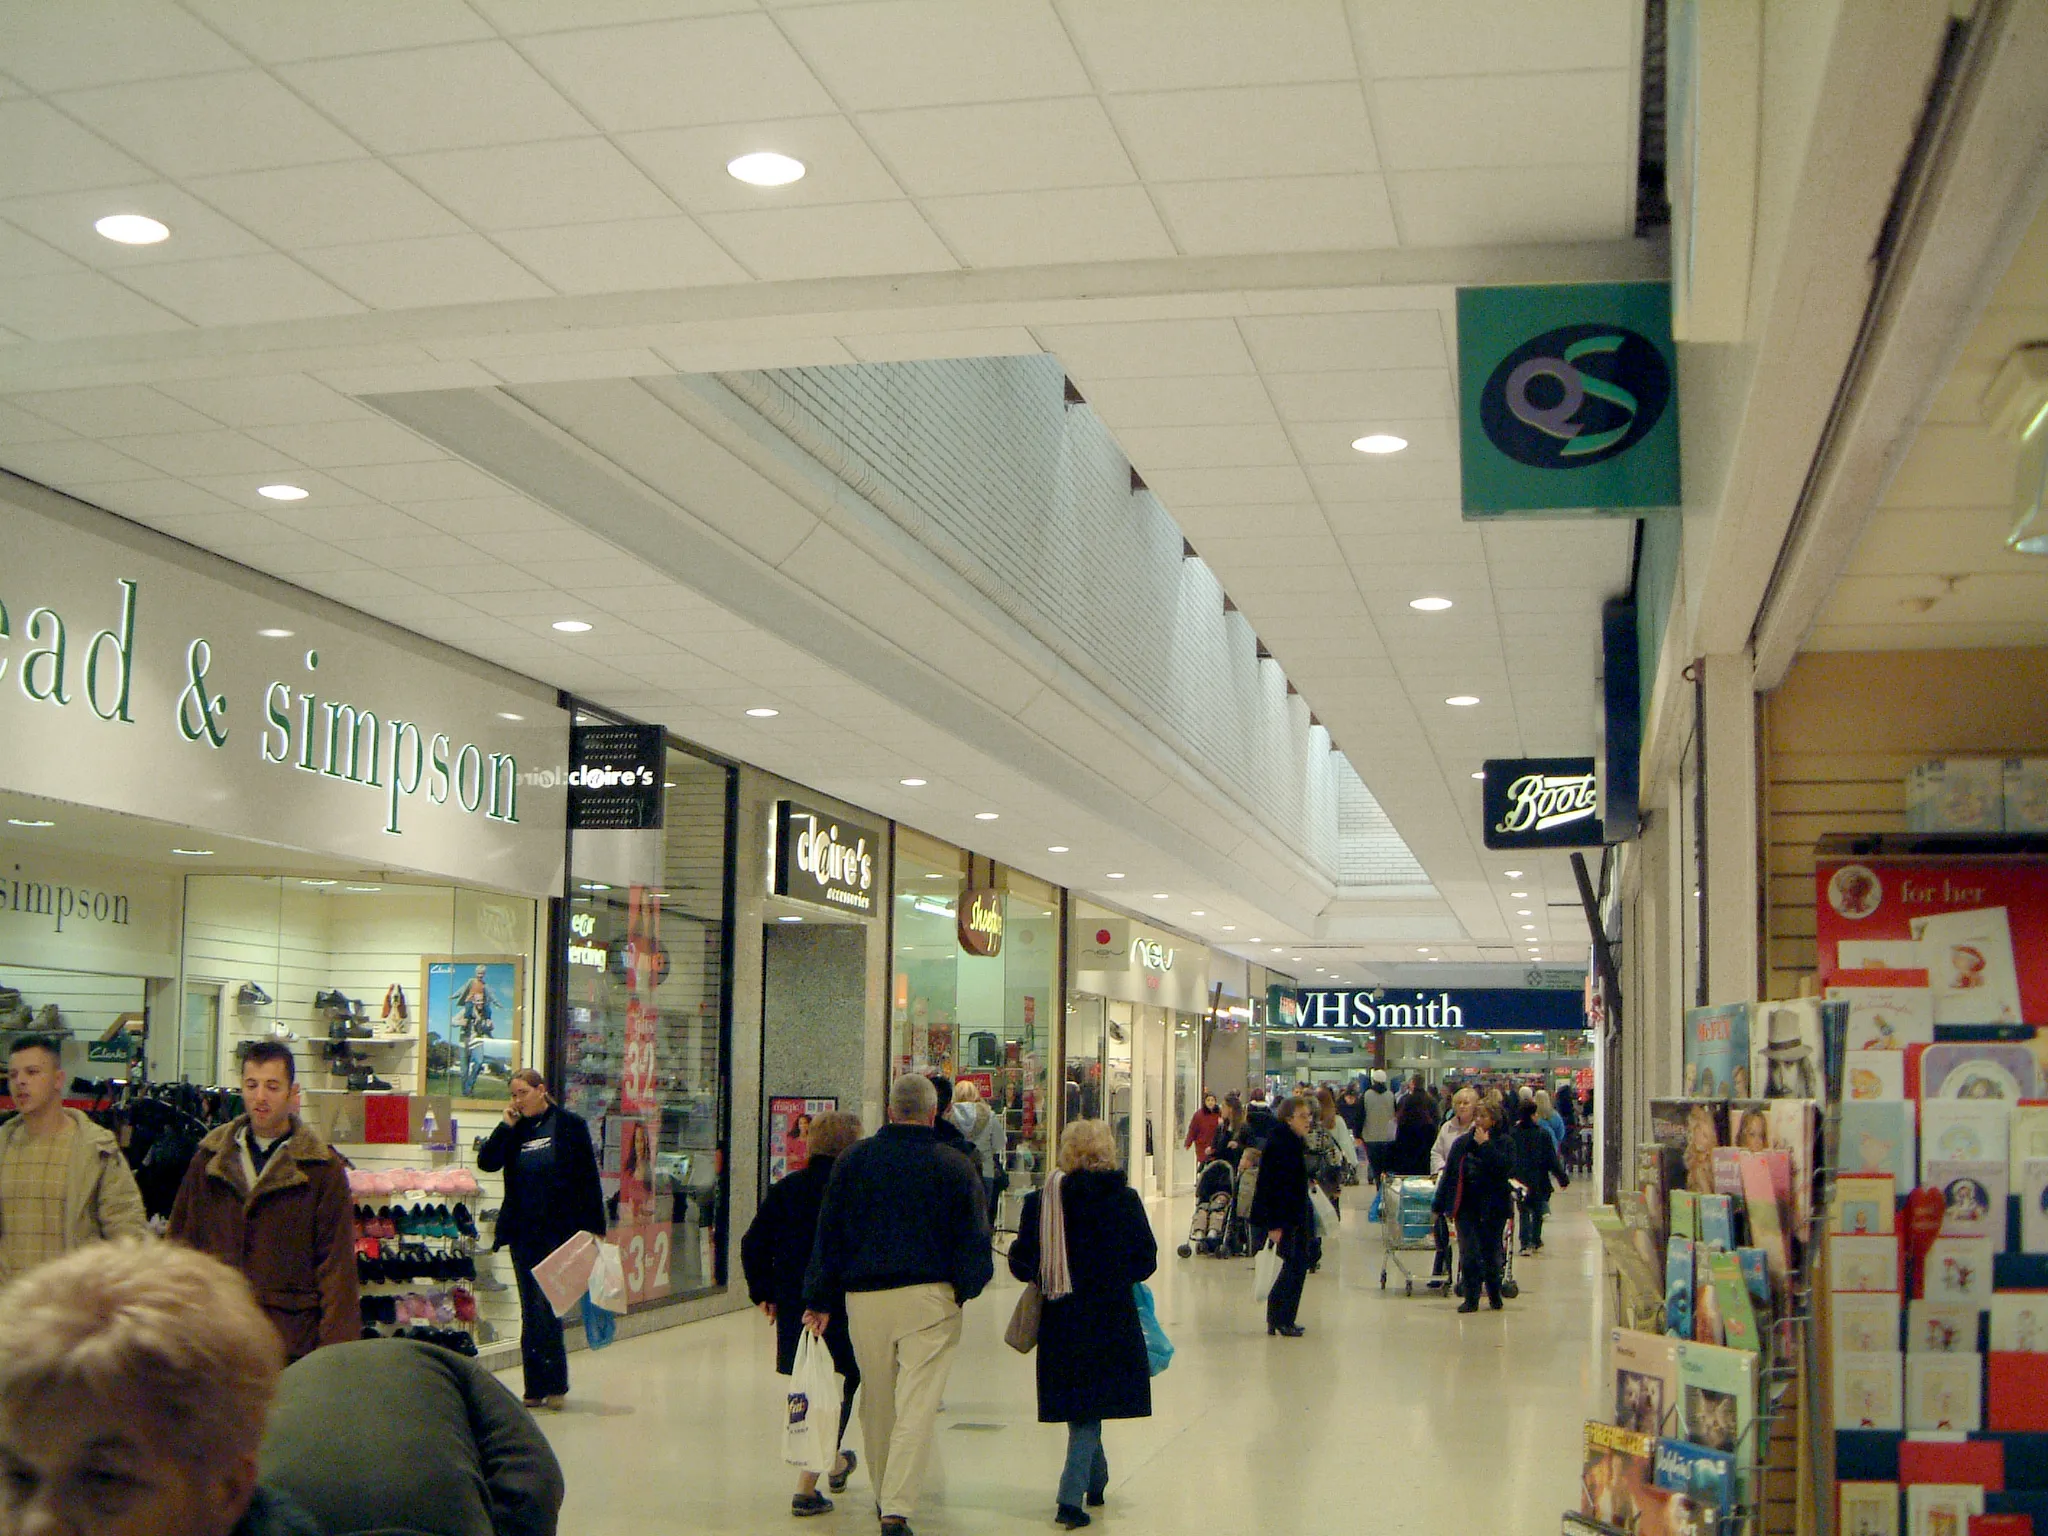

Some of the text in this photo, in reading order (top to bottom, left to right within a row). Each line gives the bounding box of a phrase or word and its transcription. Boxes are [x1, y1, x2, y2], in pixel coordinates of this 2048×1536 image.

[0, 578, 520, 836] ad & simpson
[568, 764, 654, 789] claire's
[797, 814, 872, 890] claire's
[1902, 877, 1987, 904] for her
[571, 913, 595, 937] ear
[568, 939, 607, 973] iercing
[628, 1234, 645, 1293] 3
[653, 1230, 671, 1288] 2
